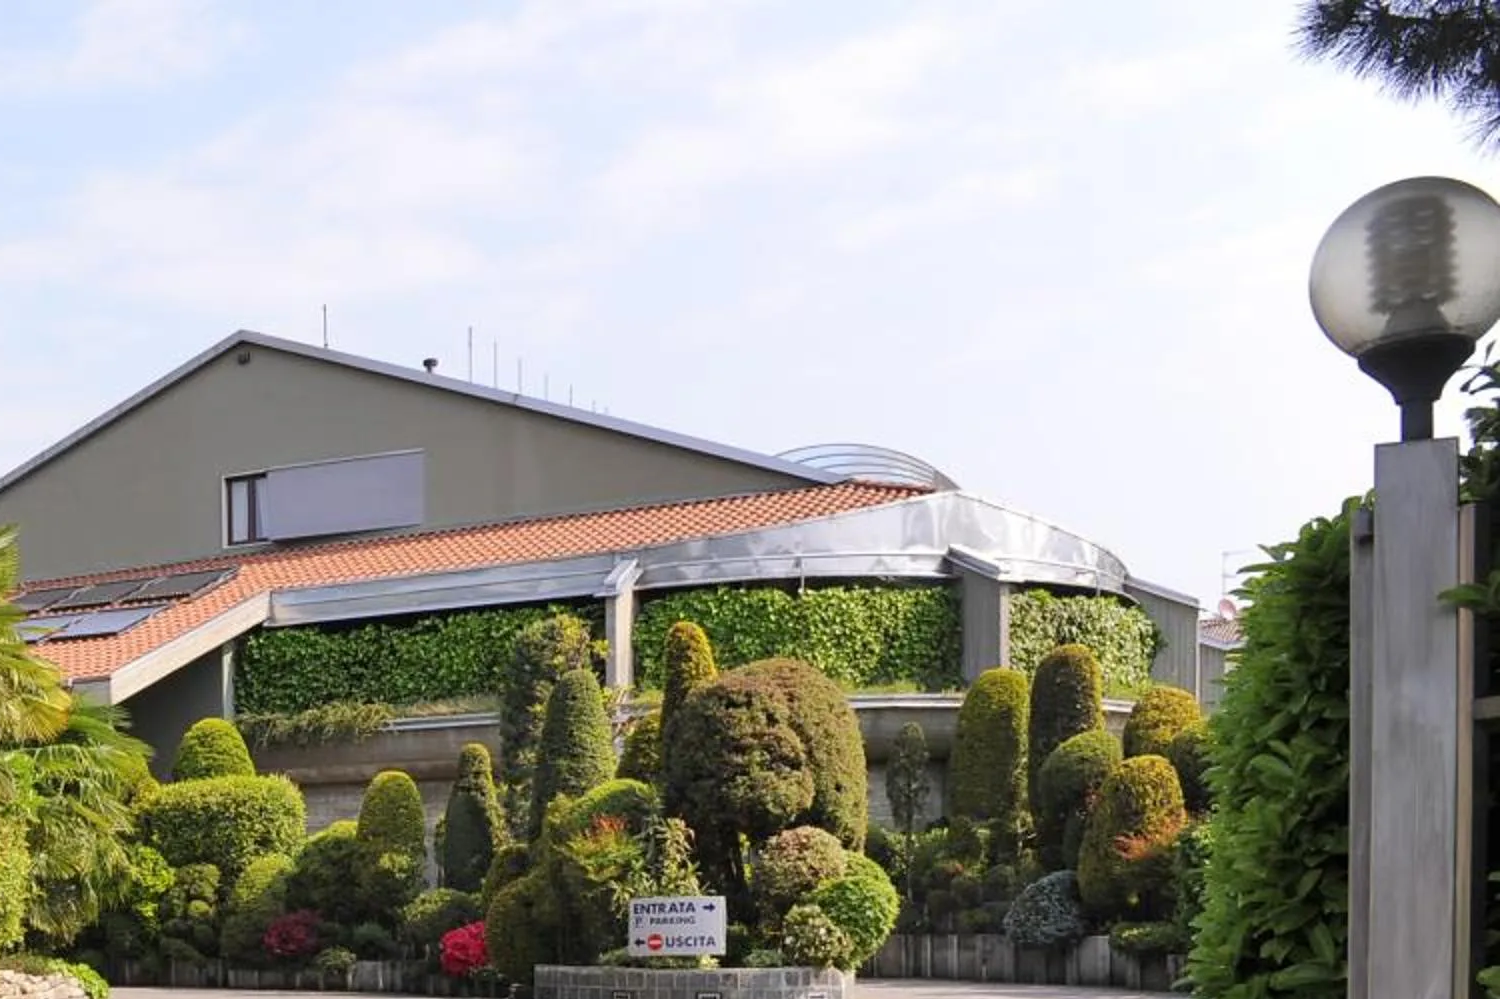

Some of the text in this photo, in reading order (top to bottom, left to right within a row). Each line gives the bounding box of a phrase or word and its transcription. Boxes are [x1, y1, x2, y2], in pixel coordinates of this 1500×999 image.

[633, 902, 696, 914] ENTRATA
[649, 916, 696, 925] PARKING
[665, 936, 717, 948] USCITA
